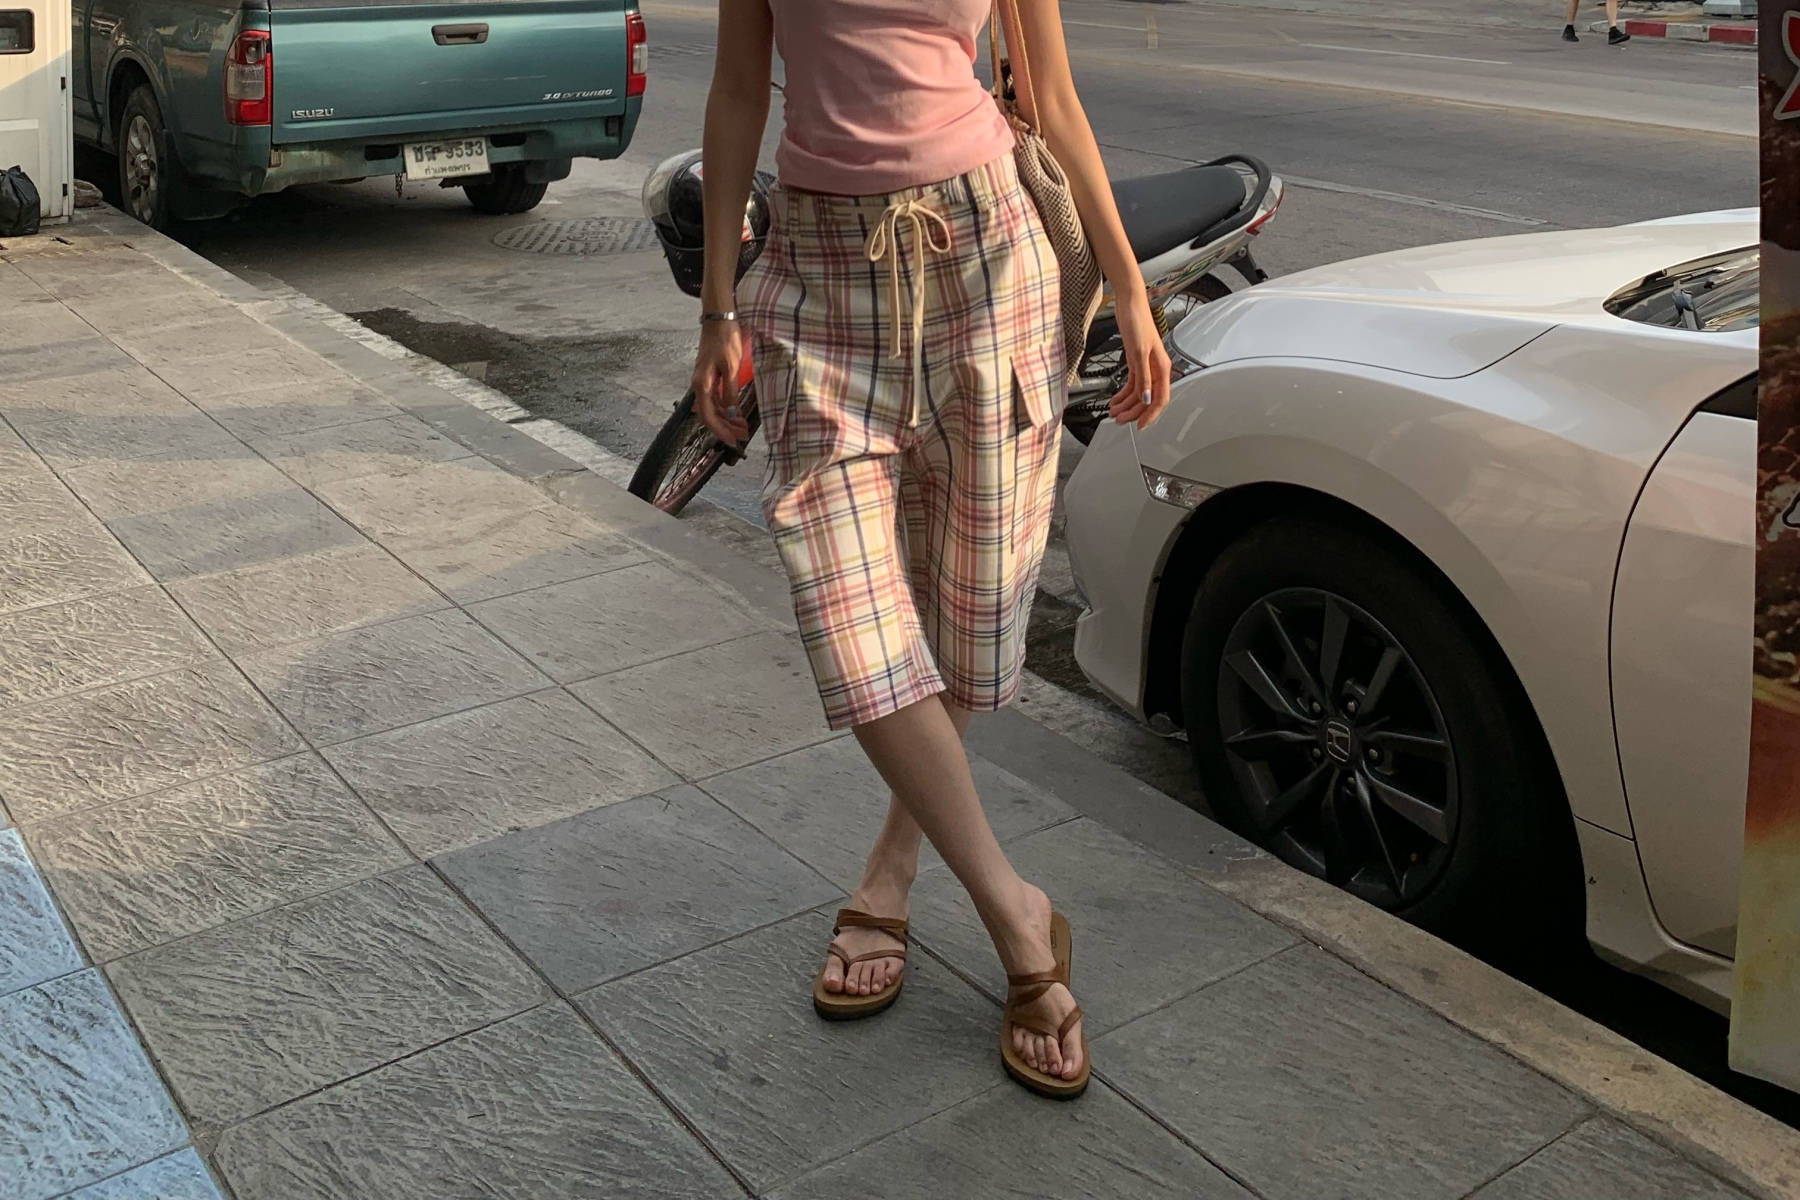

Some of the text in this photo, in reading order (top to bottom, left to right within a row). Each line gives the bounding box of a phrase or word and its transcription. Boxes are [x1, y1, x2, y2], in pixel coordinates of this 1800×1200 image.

[542, 93, 561, 101] 3.0
[575, 88, 613, 98] TURBO
[292, 107, 334, 119] ISUZU
